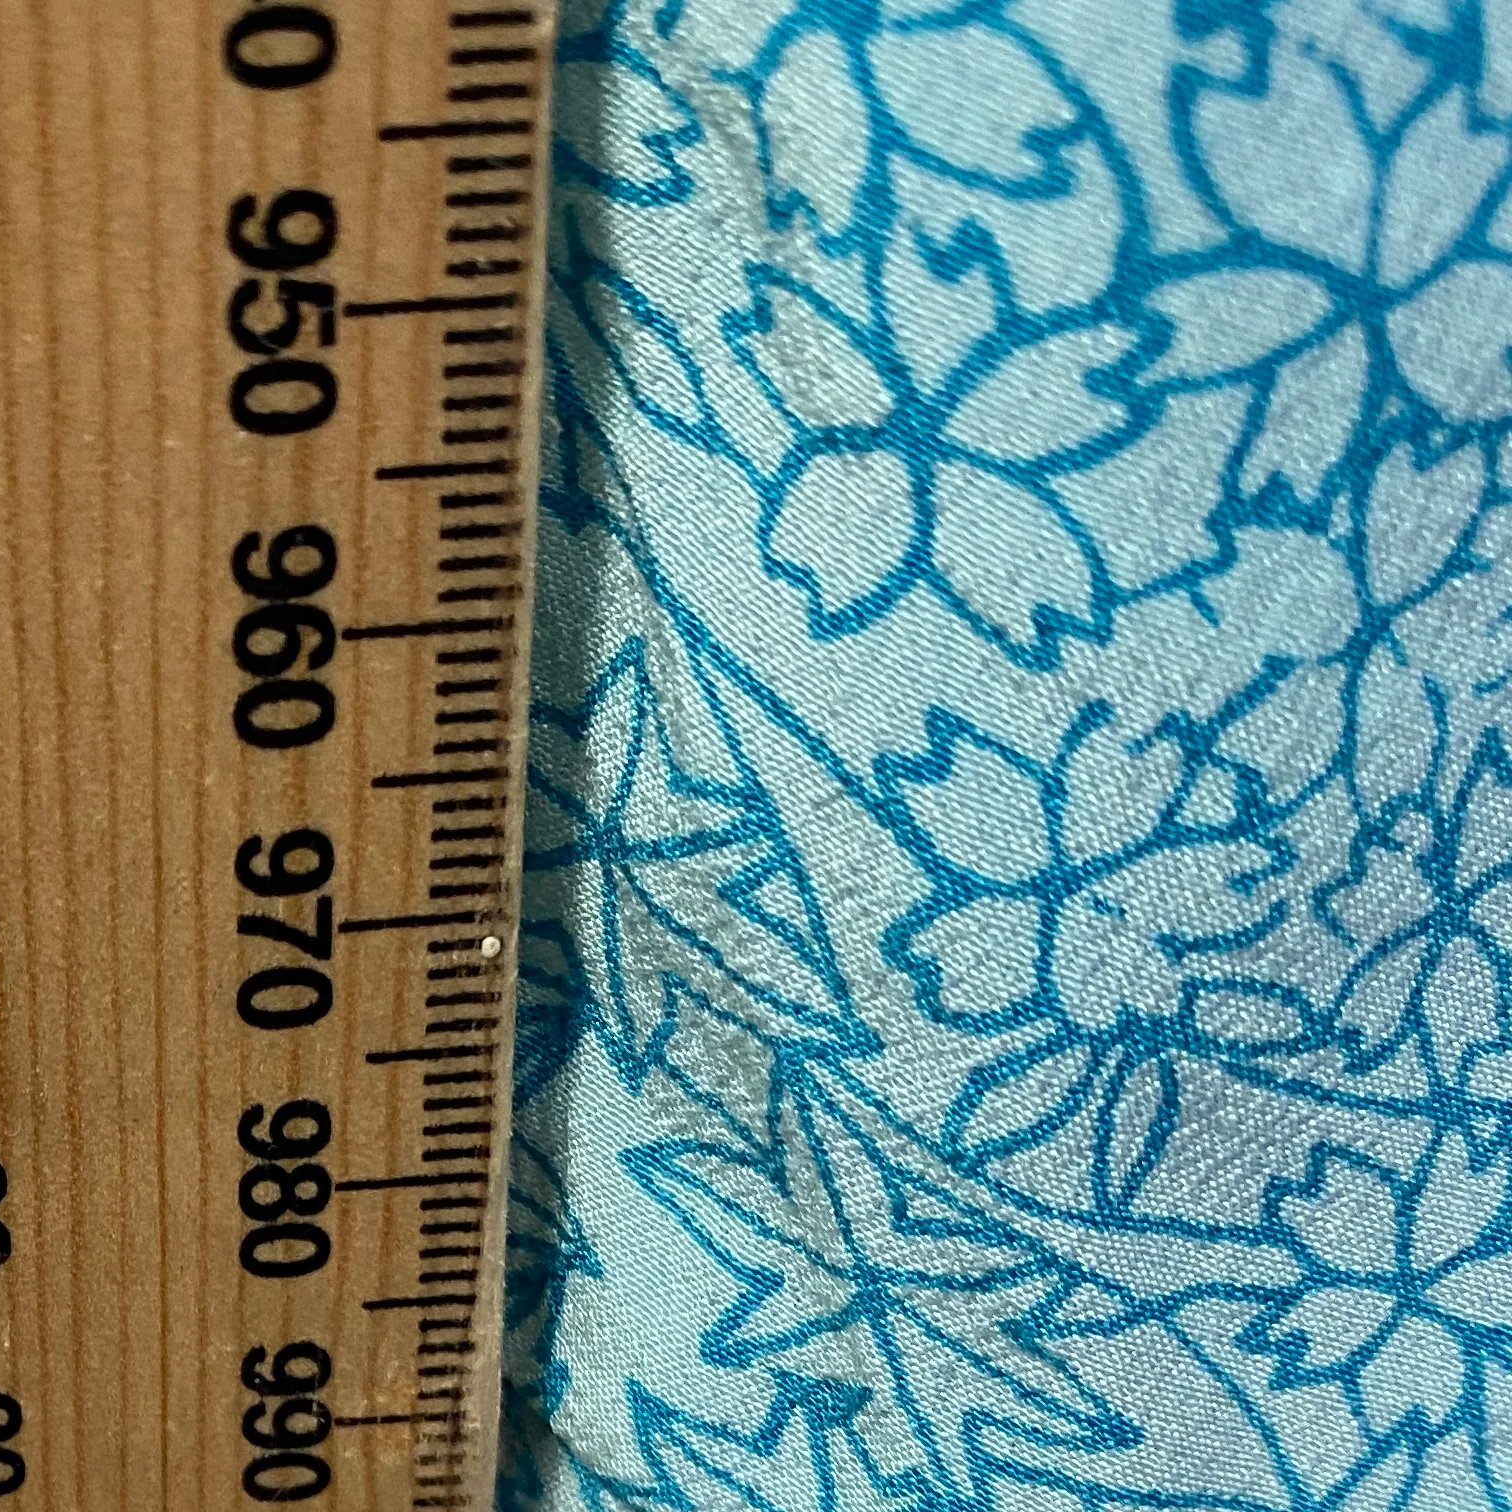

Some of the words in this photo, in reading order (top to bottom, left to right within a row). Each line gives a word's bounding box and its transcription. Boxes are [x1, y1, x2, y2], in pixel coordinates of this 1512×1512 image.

[223, 0, 339, 91] 0
[225, 187, 339, 437] 950
[230, 524, 338, 751] 960
[234, 824, 335, 1031] 970
[237, 1098, 334, 1279] 980
[239, 1340, 333, 1503] 990
